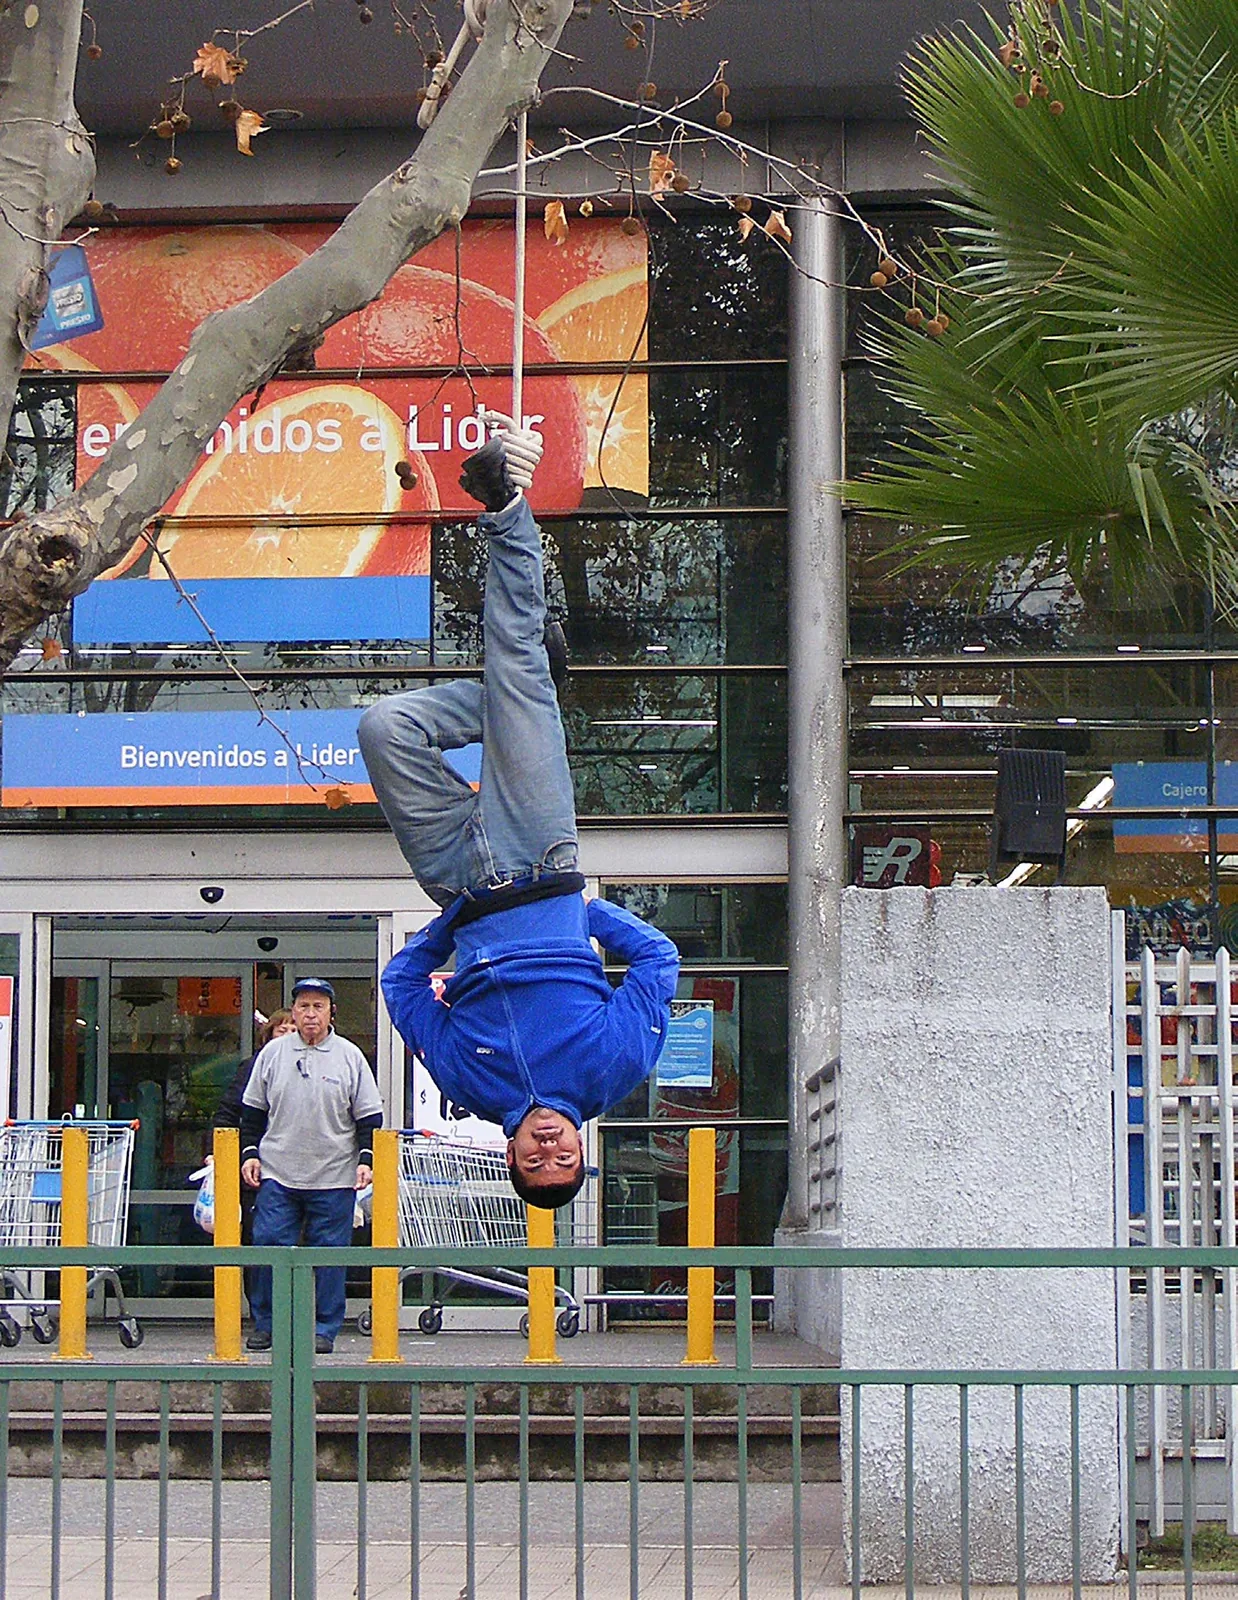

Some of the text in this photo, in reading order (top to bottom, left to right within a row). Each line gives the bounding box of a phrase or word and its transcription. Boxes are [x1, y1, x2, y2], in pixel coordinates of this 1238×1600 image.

[359, 417, 386, 452] a
[120, 743, 360, 769] Bienvenidos a Lider
